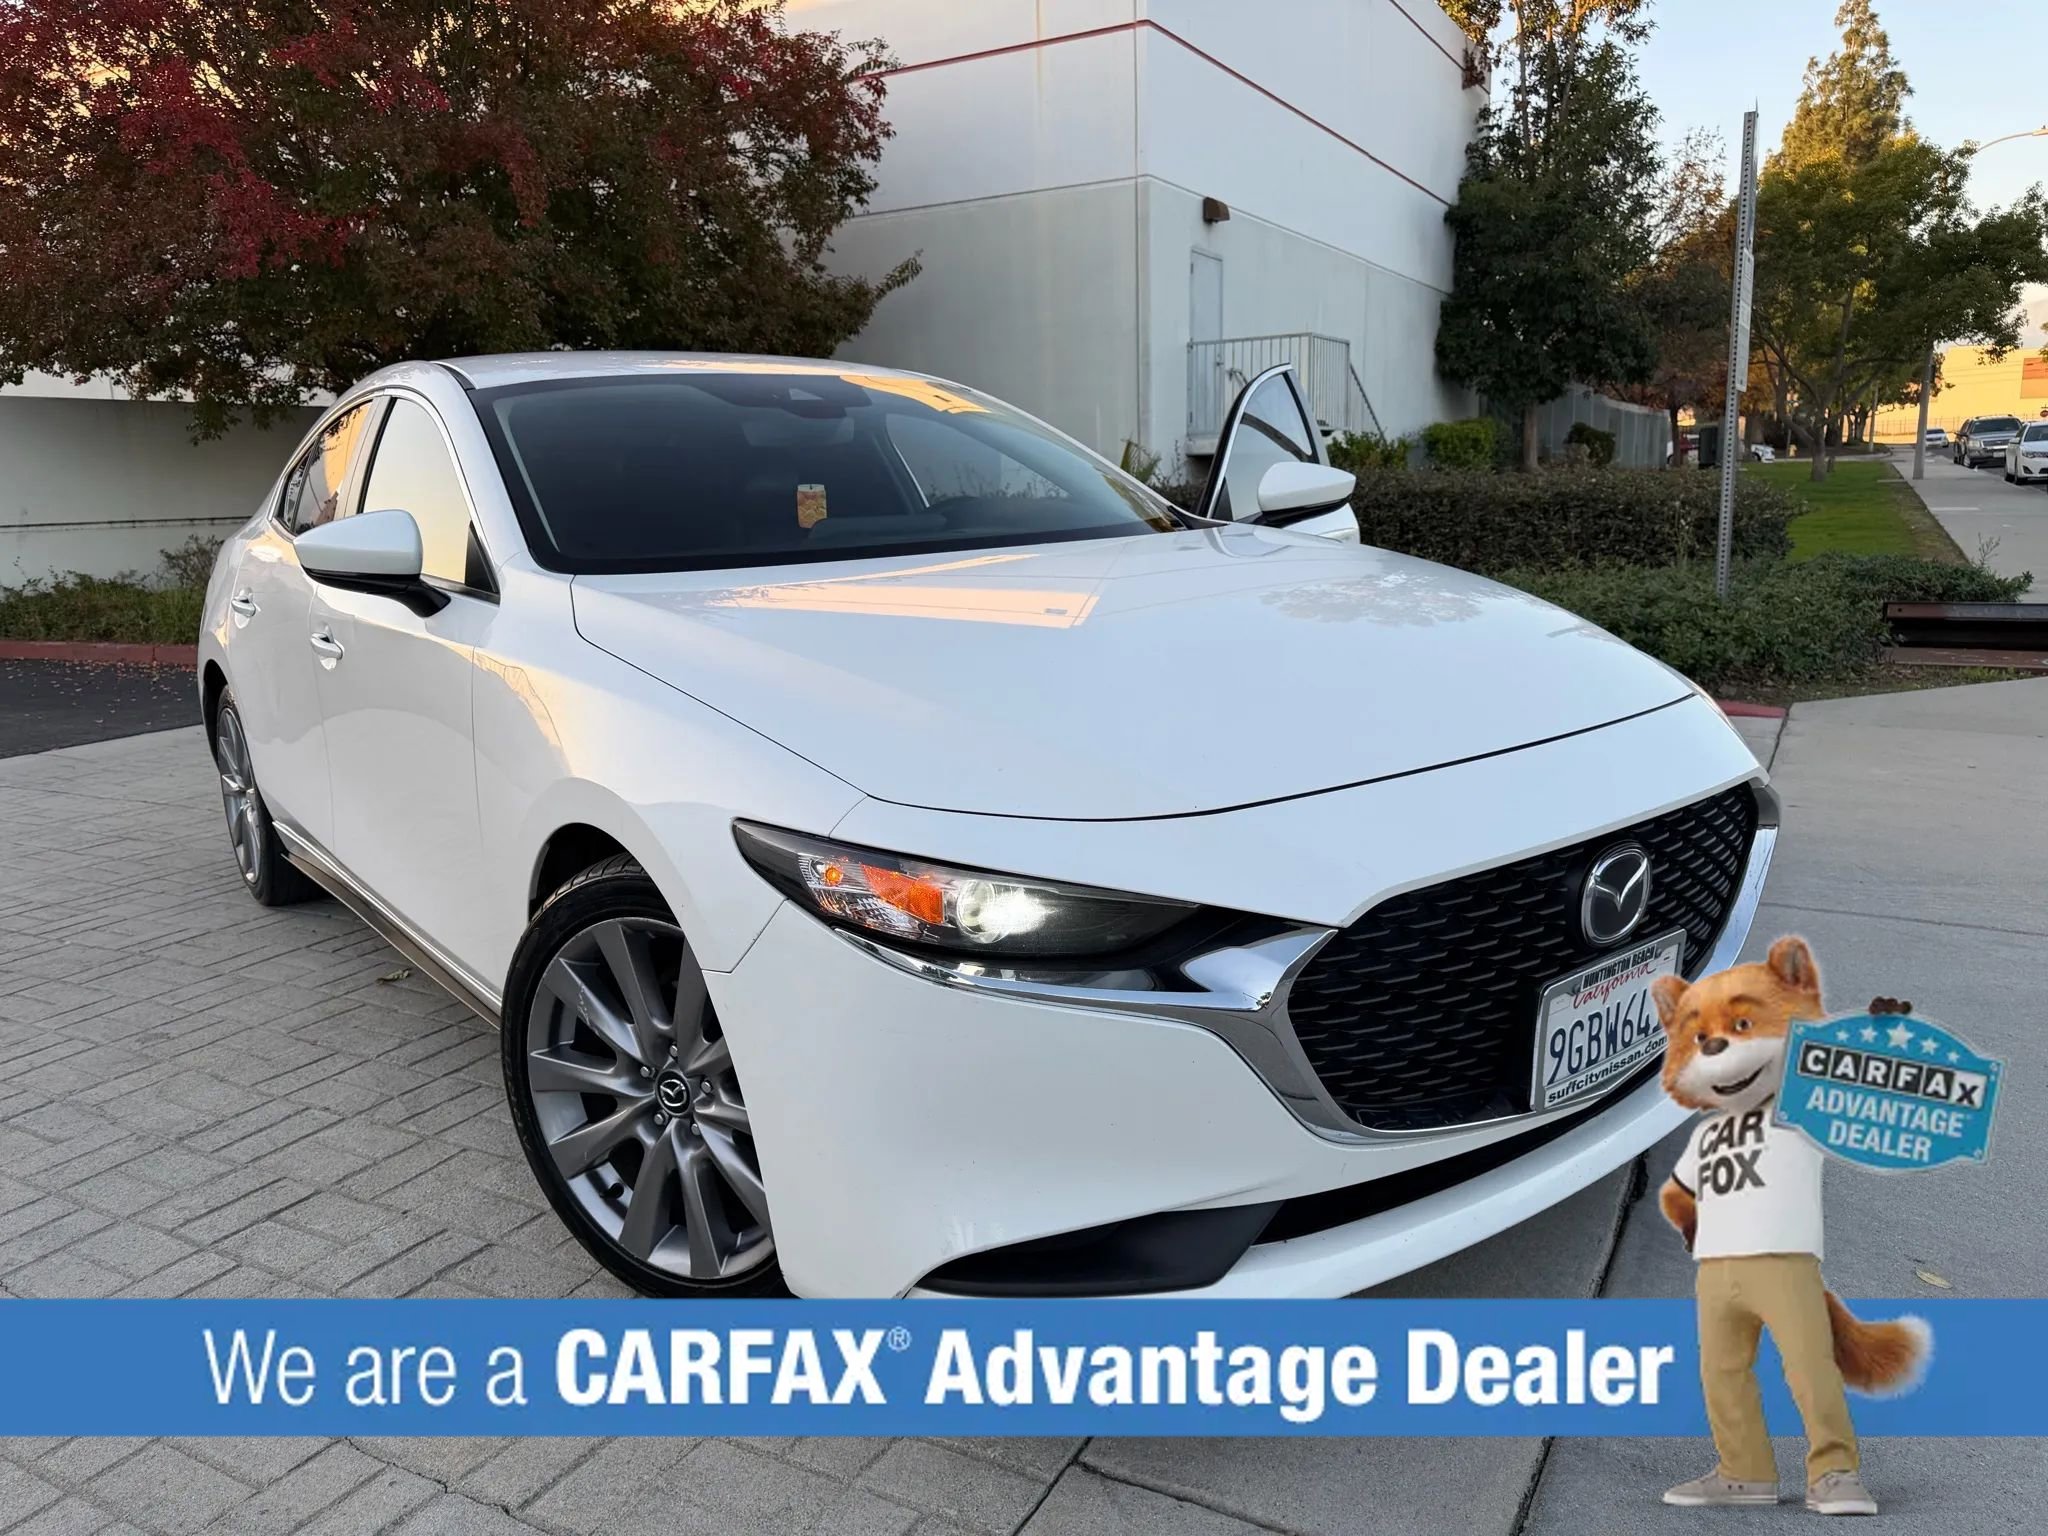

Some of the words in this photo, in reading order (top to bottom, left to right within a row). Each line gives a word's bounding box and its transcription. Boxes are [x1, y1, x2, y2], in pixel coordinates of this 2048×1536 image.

[1574, 963, 1656, 1009] California
[1583, 956, 1632, 990] HUNTINGTON
[1632, 947, 1655, 967] BEACH
[1547, 988, 1665, 1086] 9GBW64
